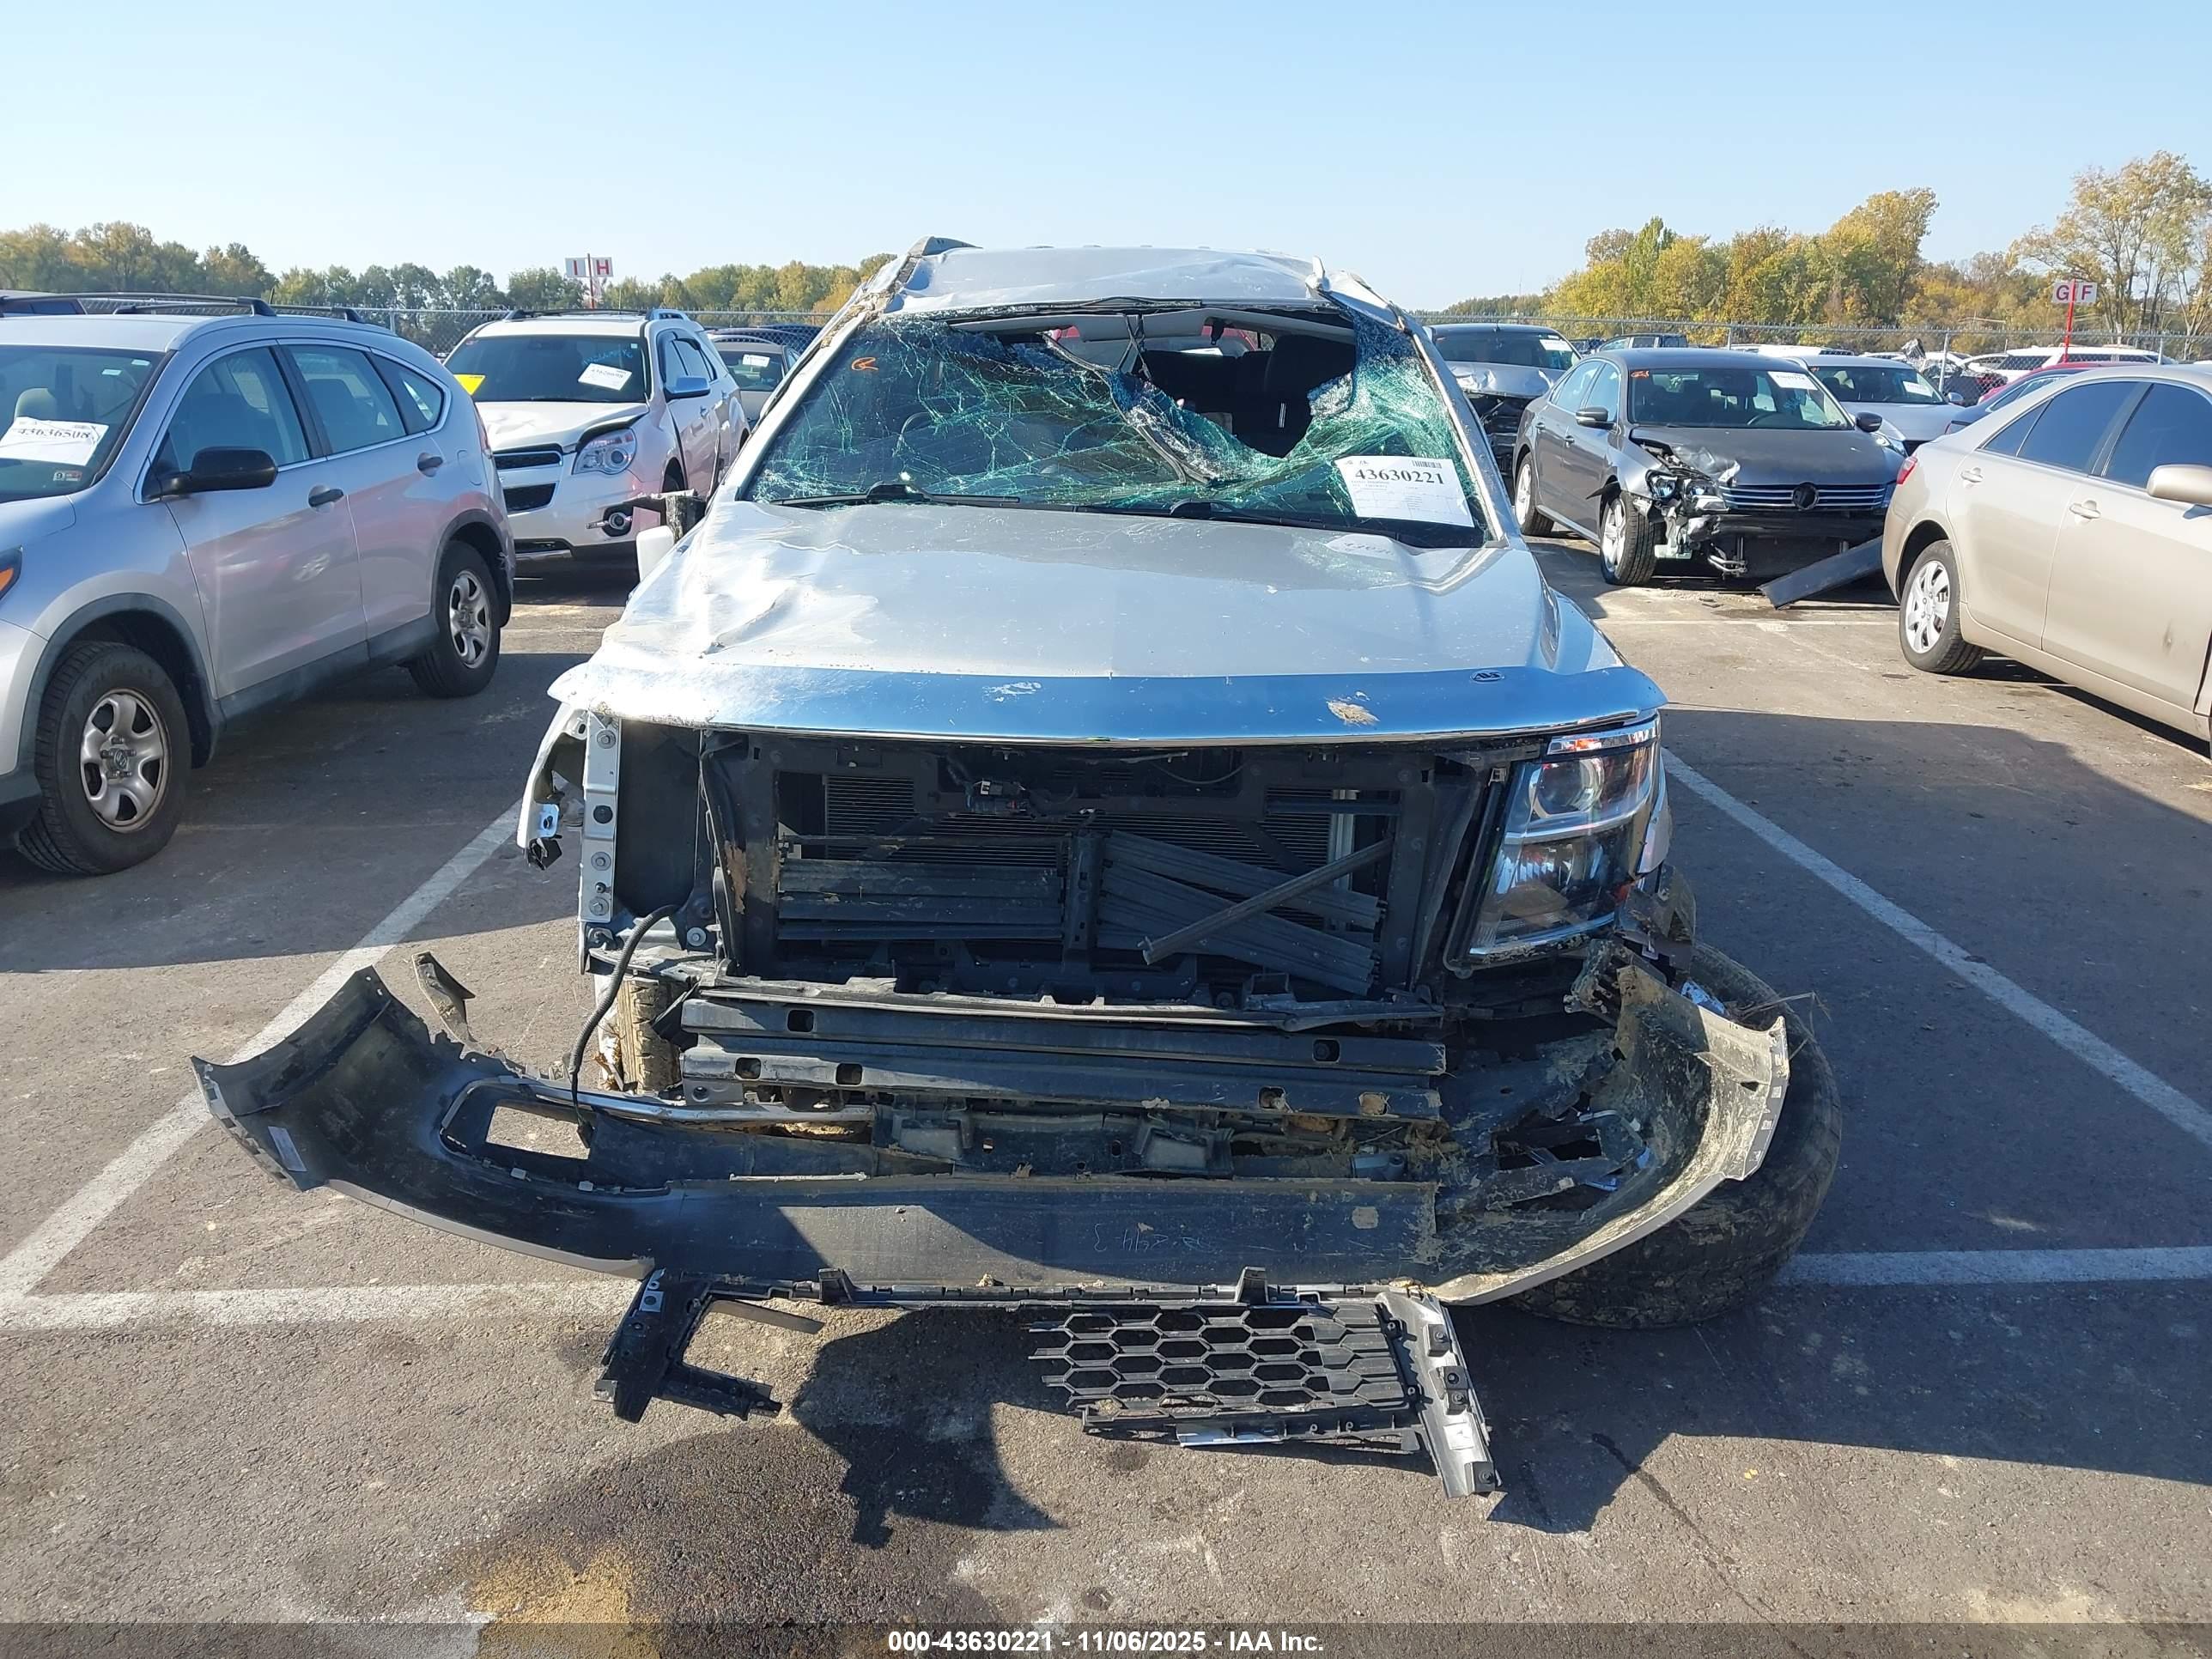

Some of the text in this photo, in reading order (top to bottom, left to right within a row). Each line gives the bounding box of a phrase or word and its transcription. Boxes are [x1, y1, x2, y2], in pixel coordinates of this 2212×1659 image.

[596, 259, 610, 275] H
[2056, 284, 2069, 301] G
[2081, 284, 2094, 301] F
[1354, 468, 1445, 485] 43630221
